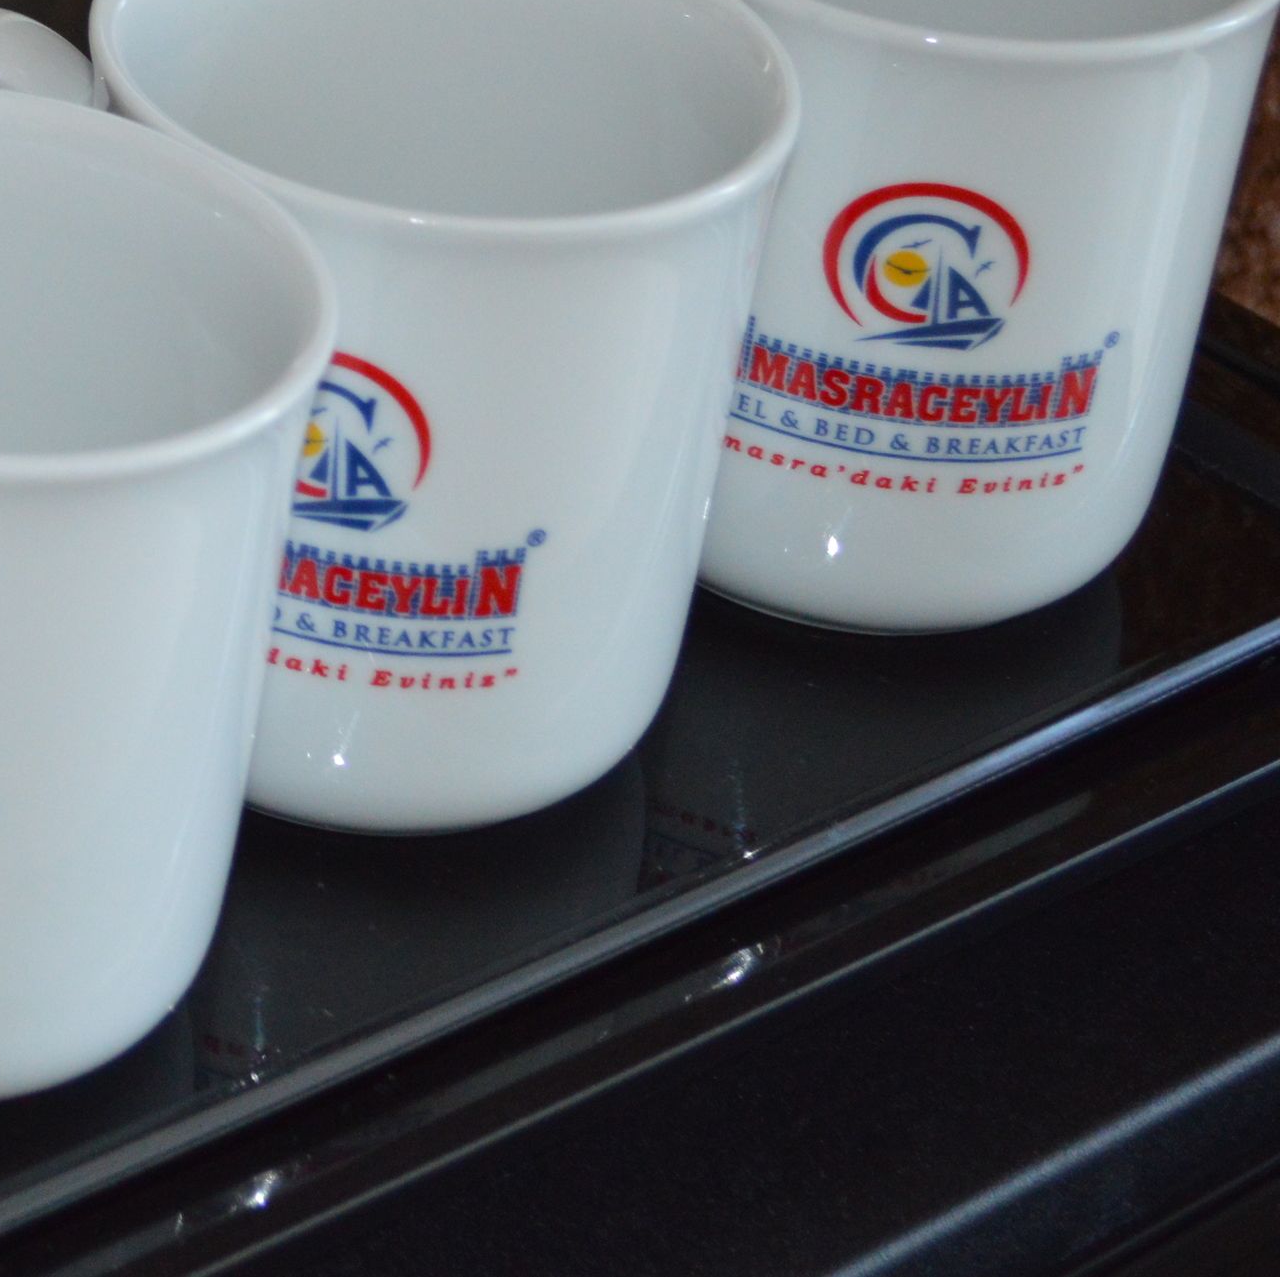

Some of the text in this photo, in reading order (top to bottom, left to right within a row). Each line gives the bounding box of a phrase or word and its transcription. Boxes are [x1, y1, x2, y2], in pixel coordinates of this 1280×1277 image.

[736, 343, 1098, 426] MASRACEYLIN
[780, 407, 801, 430] &
[813, 417, 876, 446] BED
[889, 433, 912, 452] &
[924, 426, 1088, 455] BREAKFAST
[331, 618, 516, 650] BREAKFAST
